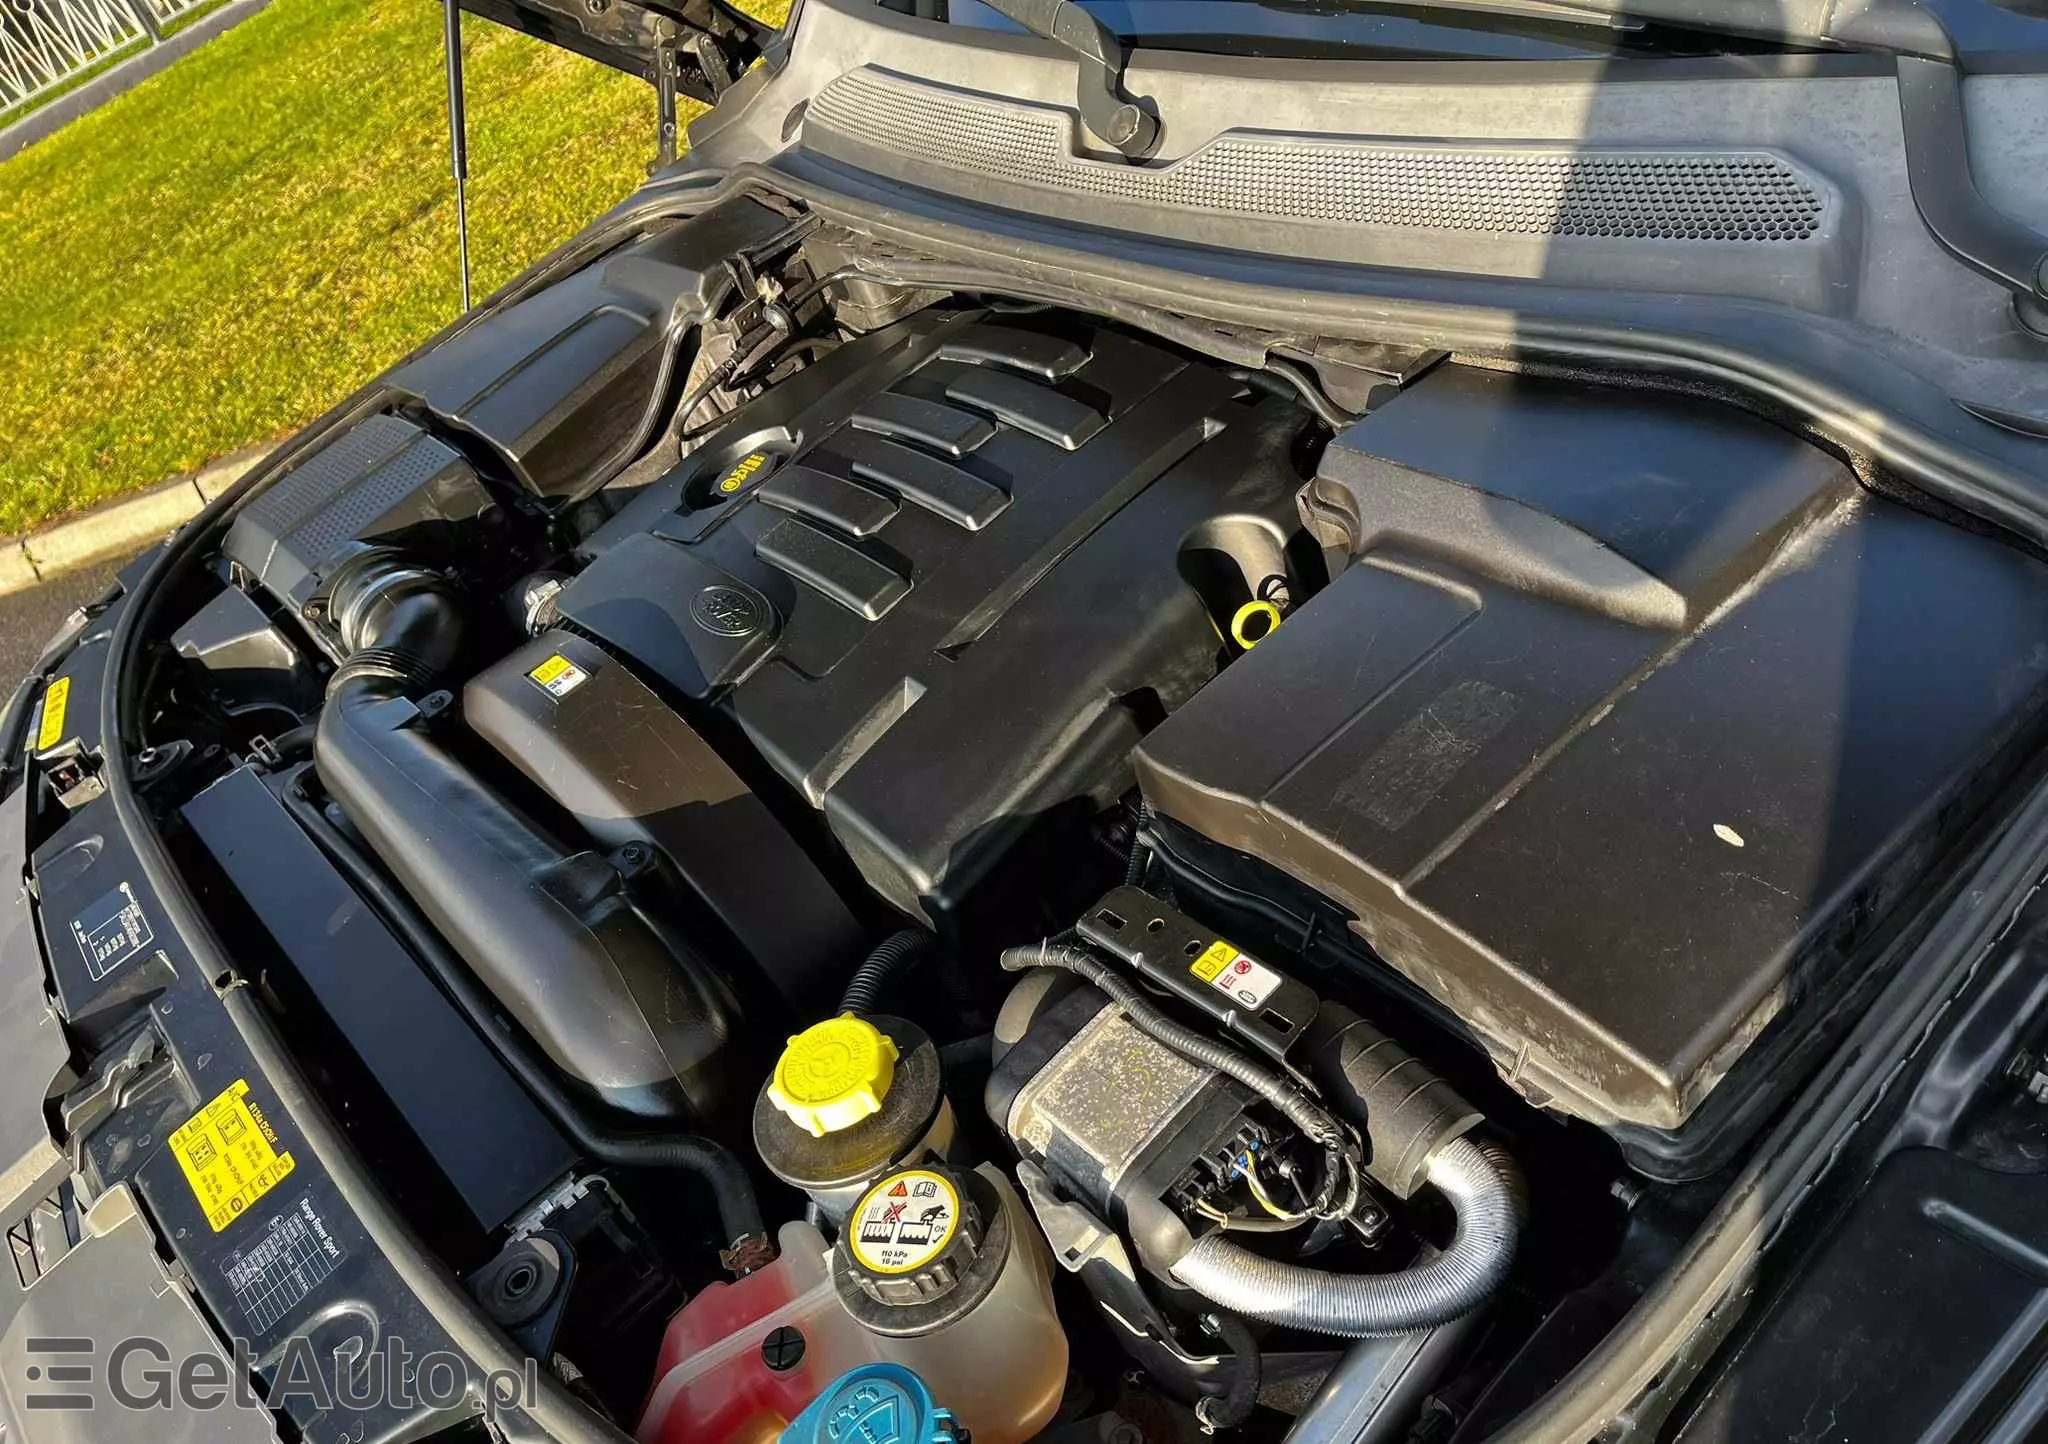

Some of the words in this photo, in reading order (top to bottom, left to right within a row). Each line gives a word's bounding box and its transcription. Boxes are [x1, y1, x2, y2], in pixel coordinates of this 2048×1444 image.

[300, 1198, 316, 1221] Range
[311, 1217, 328, 1240] Rover
[323, 1236, 340, 1259] Sport
[934, 1225, 947, 1233] OK
[893, 1250, 908, 1258] kPa
